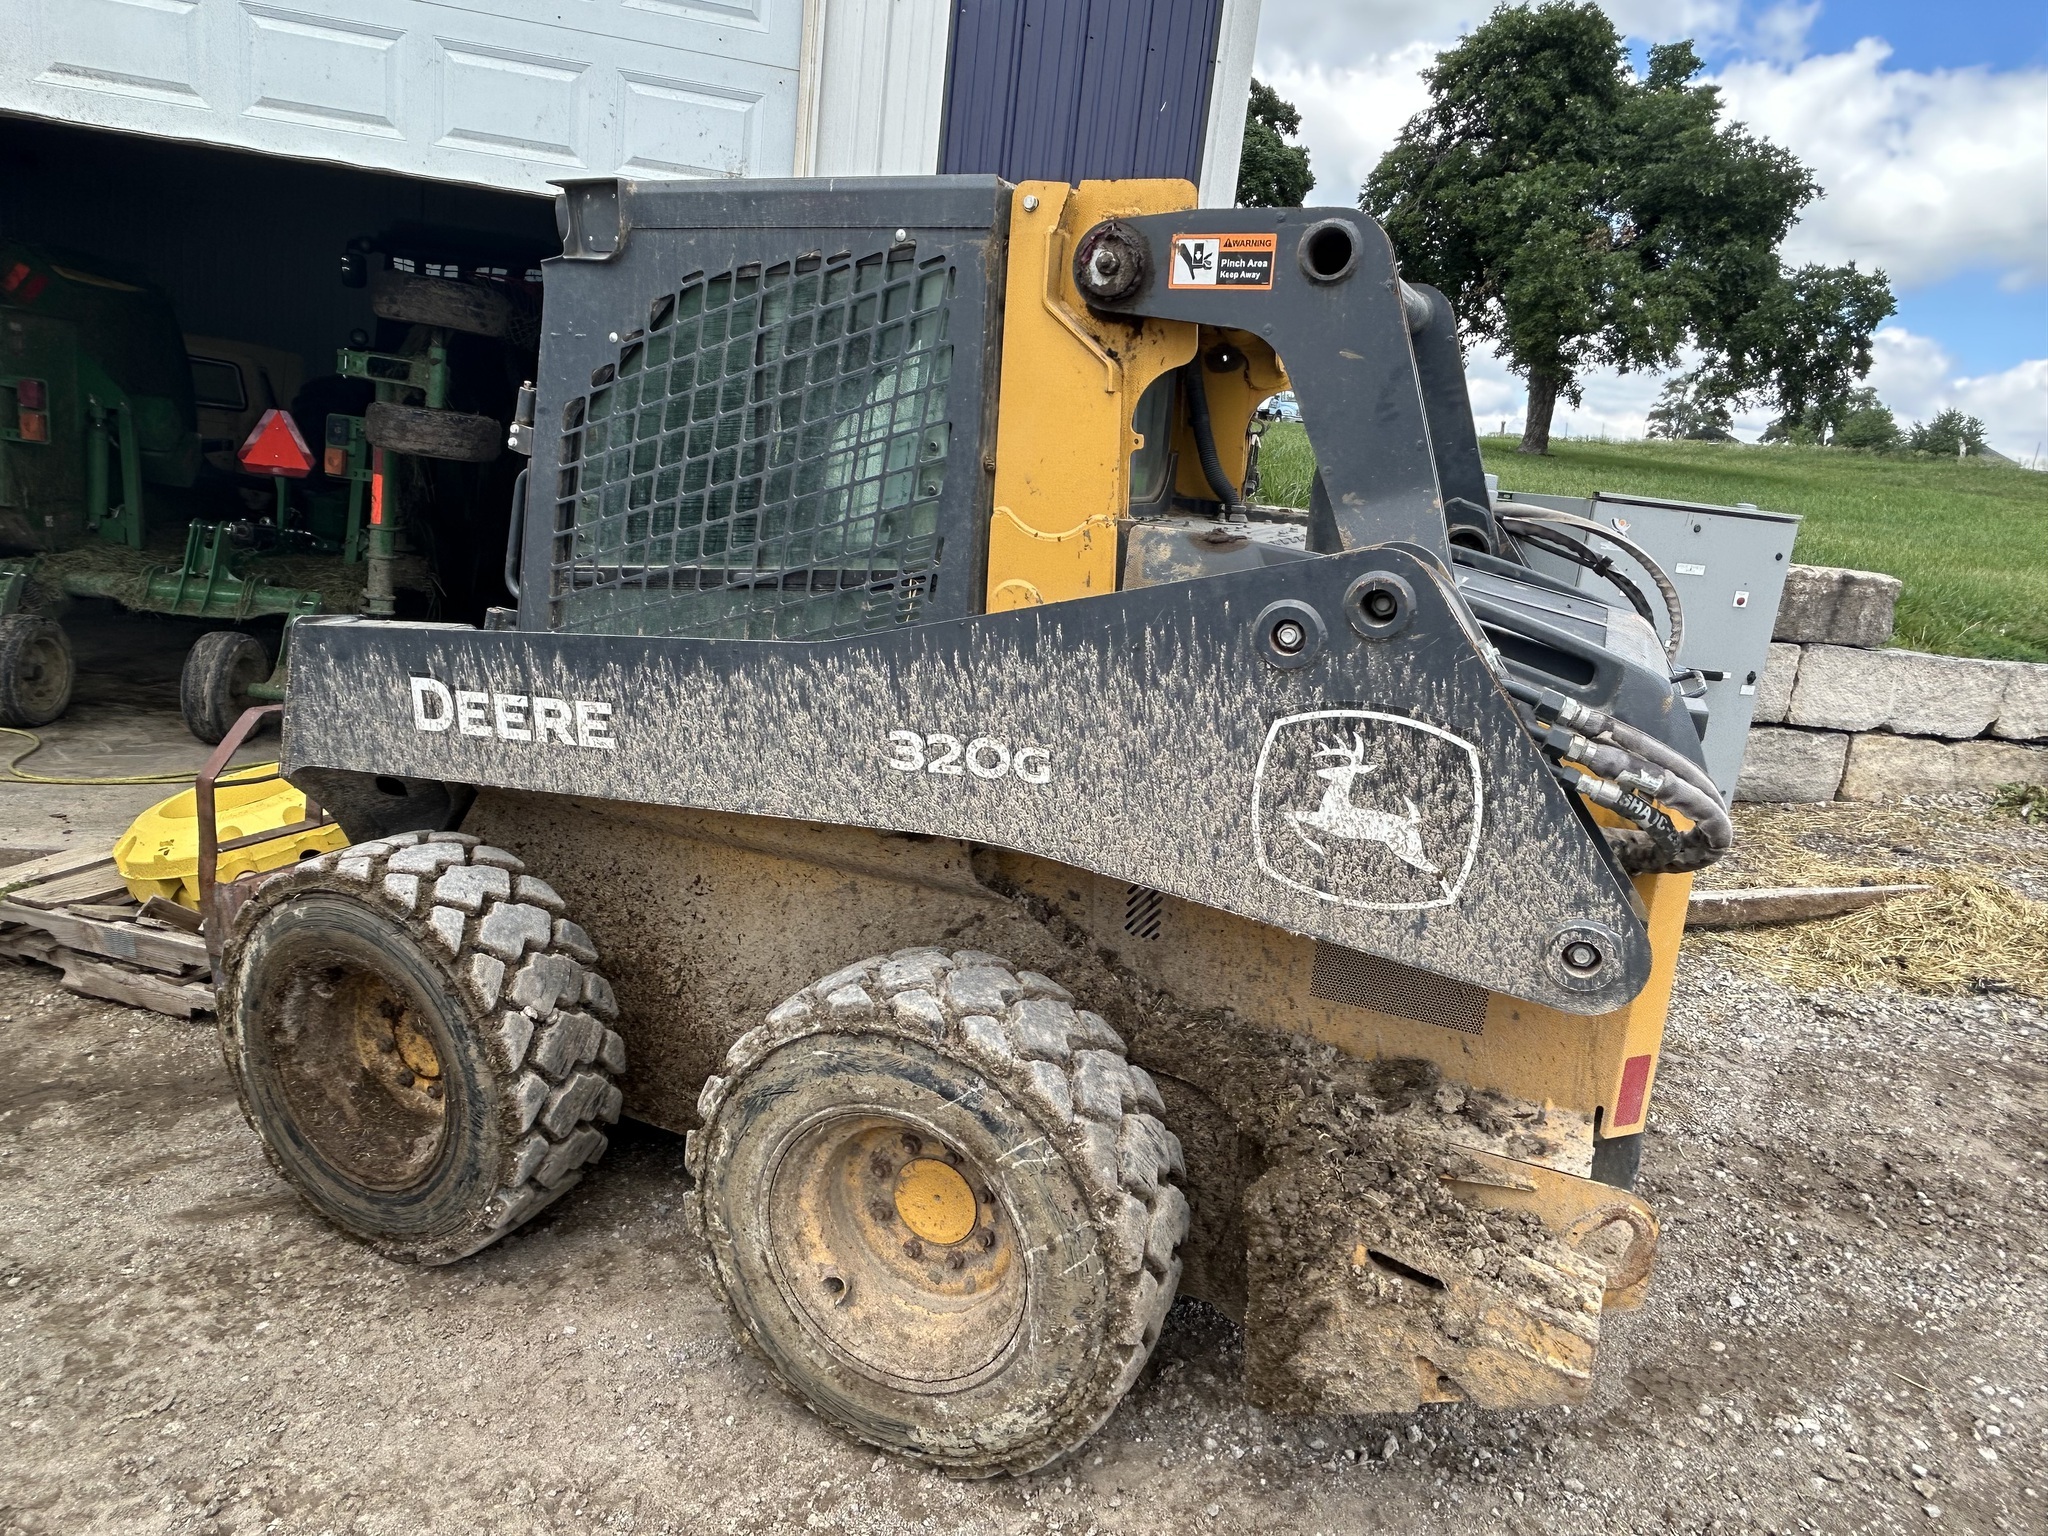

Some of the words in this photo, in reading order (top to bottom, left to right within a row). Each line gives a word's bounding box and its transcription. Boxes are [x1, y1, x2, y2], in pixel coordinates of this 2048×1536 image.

[1233, 239, 1272, 248] WARNING
[1220, 258, 1246, 268] Pinch
[1247, 259, 1268, 268] Area
[1220, 271, 1239, 280] Keep
[1240, 271, 1261, 280] Away
[410, 676, 616, 749] DEERE
[886, 730, 1051, 784] 320G
